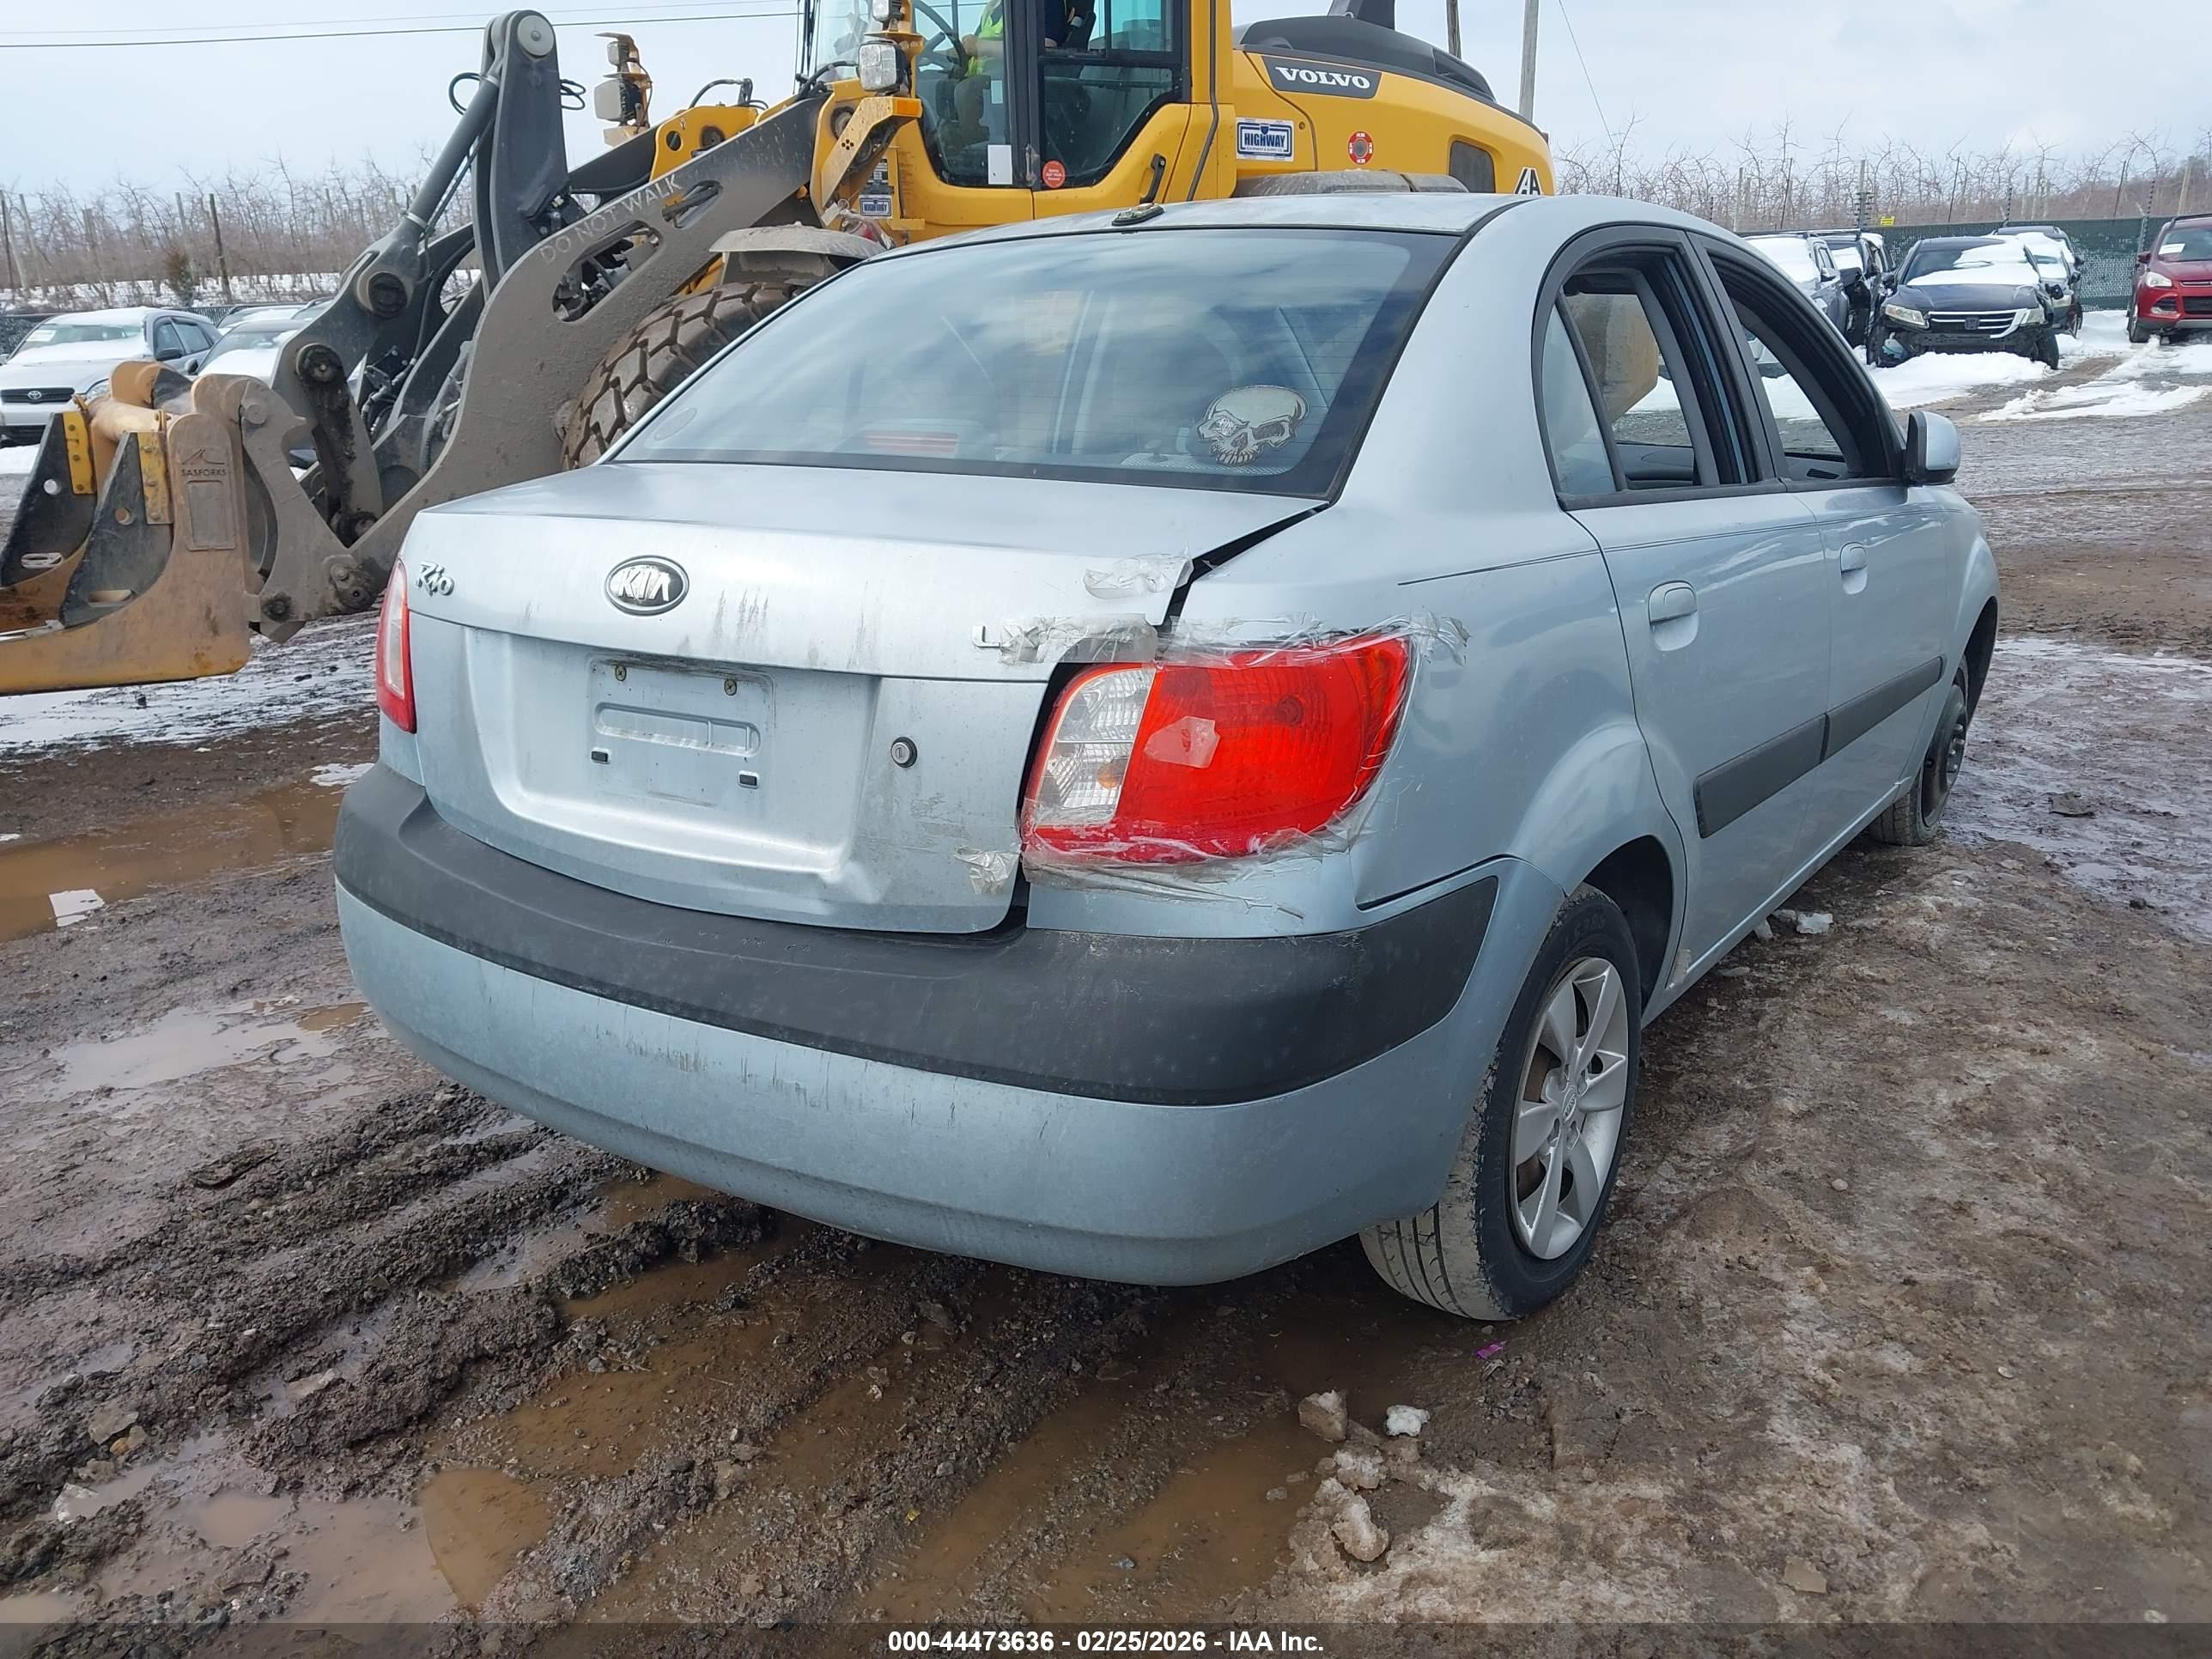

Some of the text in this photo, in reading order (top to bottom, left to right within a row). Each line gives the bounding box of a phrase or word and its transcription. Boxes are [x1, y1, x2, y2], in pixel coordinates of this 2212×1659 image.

[1275, 67, 1370, 88] VOLVO
[1243, 133, 1285, 147] HIGHWAY
[540, 174, 682, 263] DO NOT WALK
[415, 561, 454, 597] Rio
[617, 567, 671, 601] KIA
